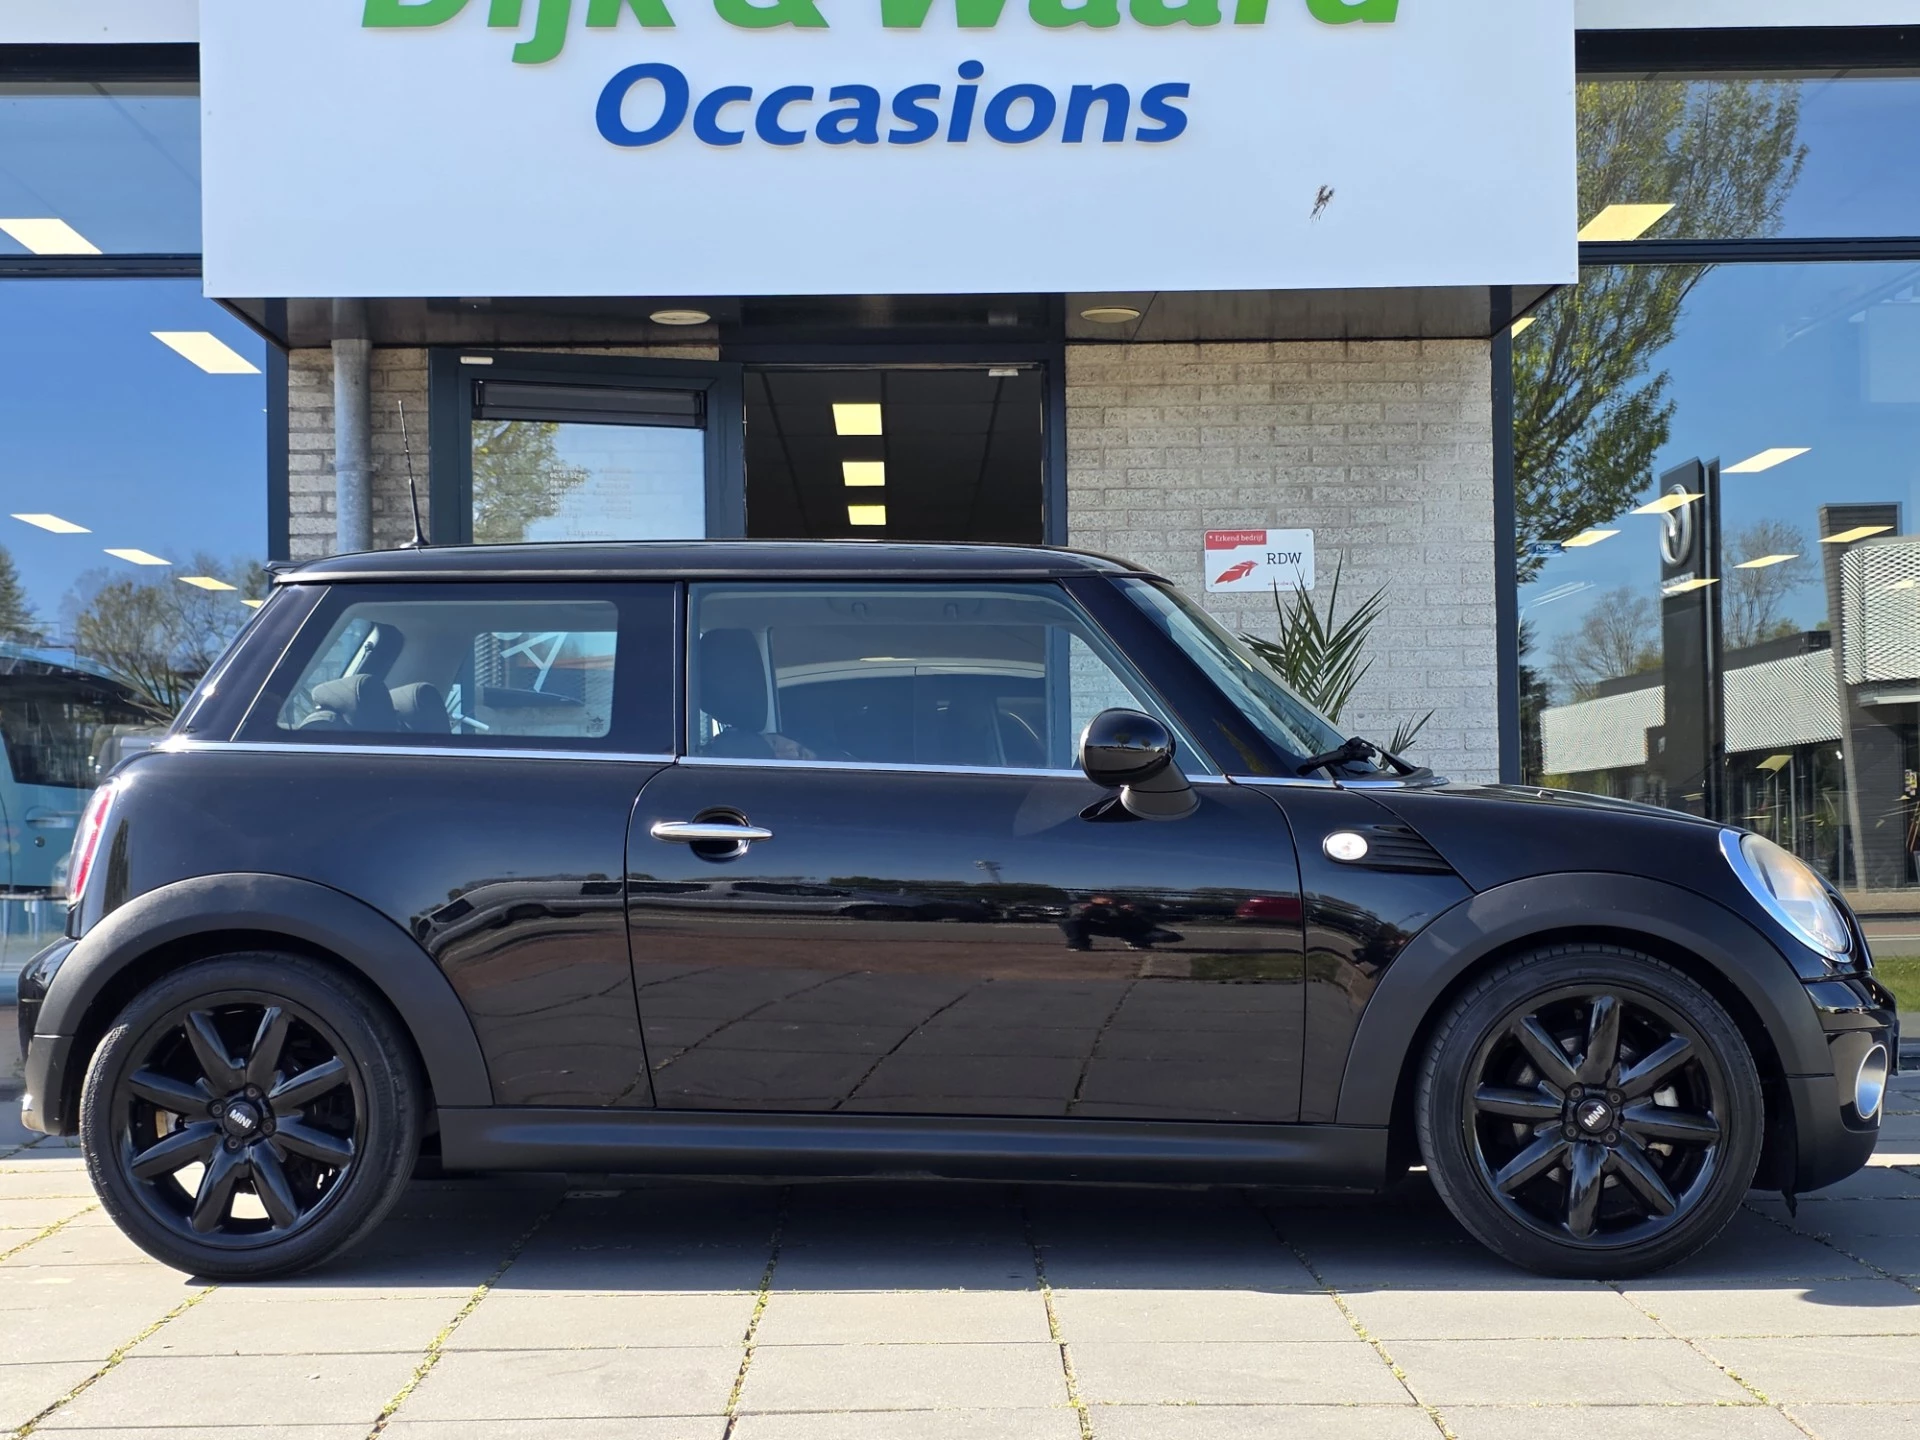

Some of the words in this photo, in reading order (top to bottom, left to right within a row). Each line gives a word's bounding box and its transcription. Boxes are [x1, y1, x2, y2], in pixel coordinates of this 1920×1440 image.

[595, 60, 1190, 148] Occasions
[1215, 534, 1239, 542] Erkend
[1240, 534, 1264, 543] bedrijf
[1266, 552, 1302, 565] RDW
[229, 1108, 252, 1129] MINI
[1583, 1104, 1606, 1127] MINI
